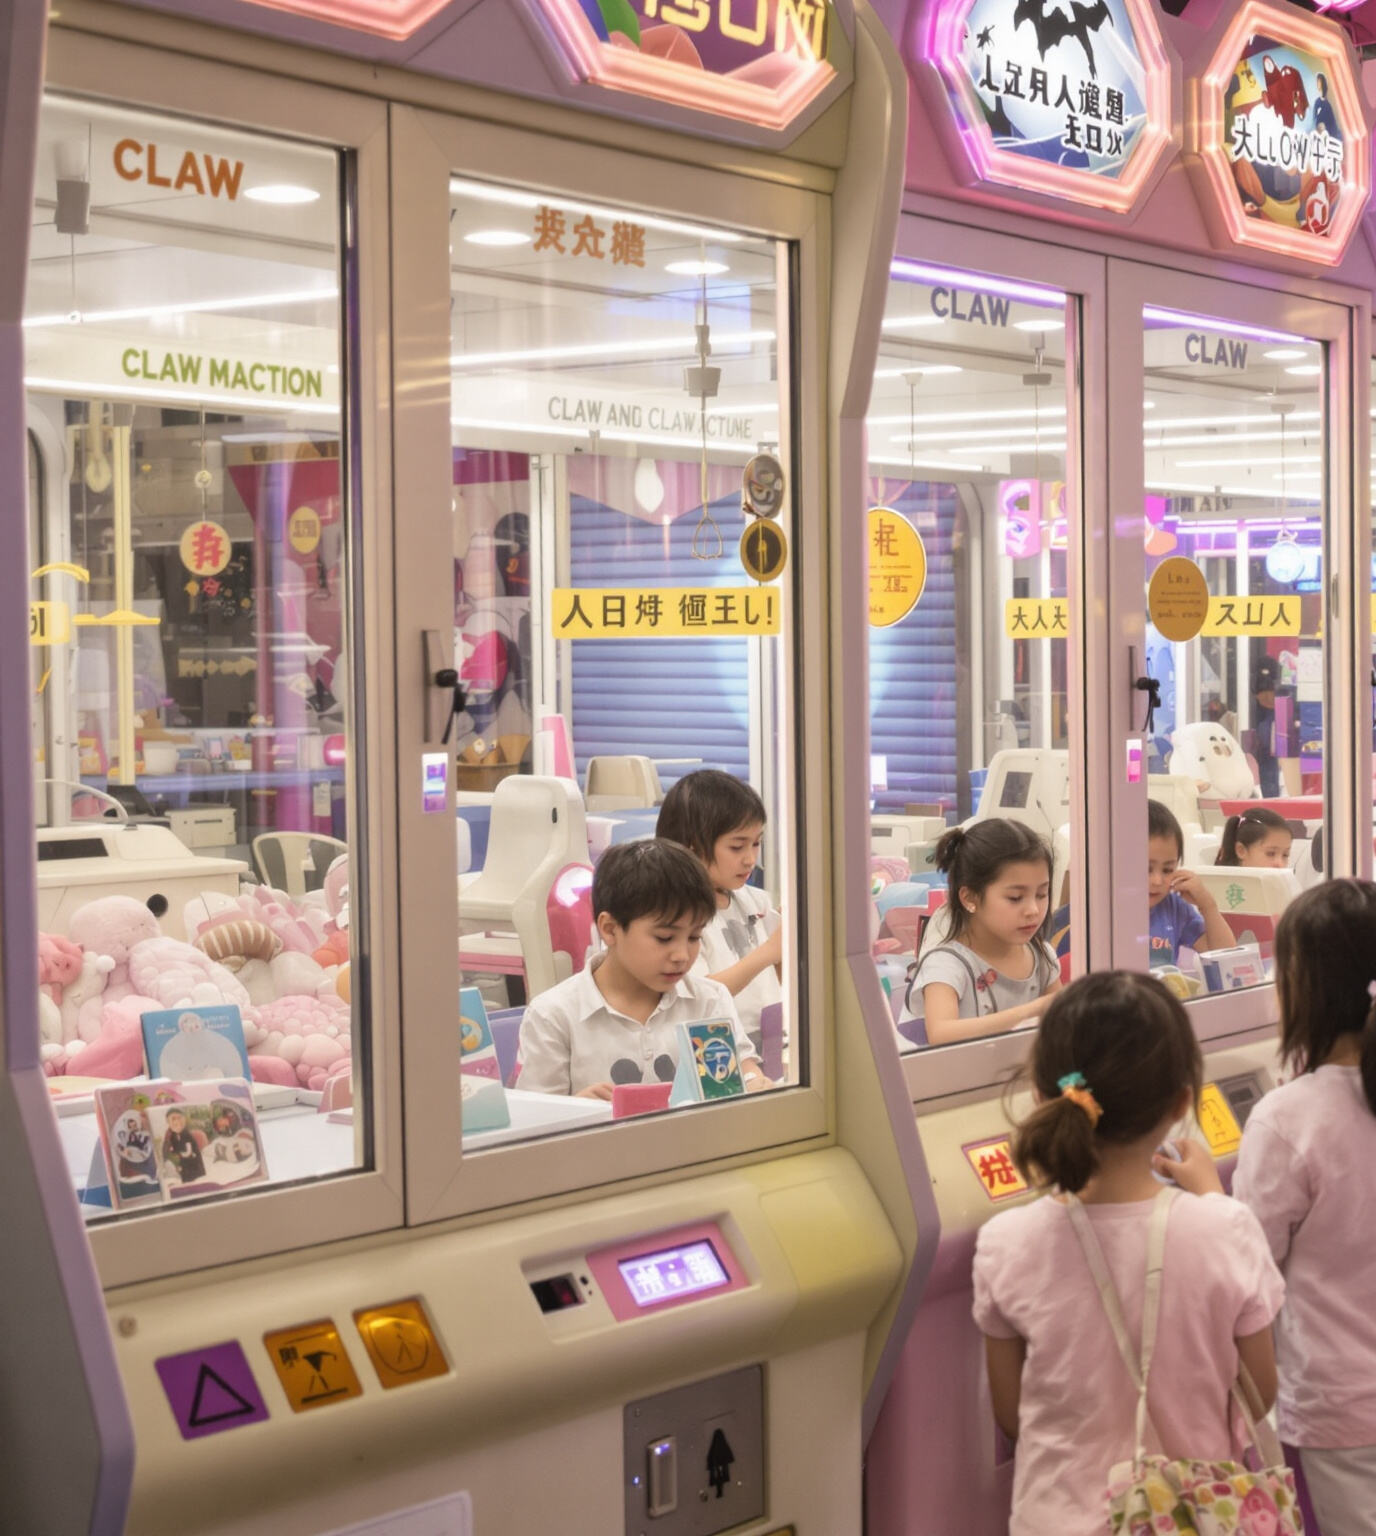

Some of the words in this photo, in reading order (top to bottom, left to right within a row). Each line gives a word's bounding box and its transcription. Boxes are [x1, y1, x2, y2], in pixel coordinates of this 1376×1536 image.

[113, 138, 245, 202] CLAW
[931, 286, 1010, 327] CLAW
[1185, 333, 1248, 369] CLAW
[121, 348, 202, 385] CLAW
[209, 358, 322, 398] MACTION
[548, 396, 602, 424] CLAW
[606, 403, 642, 428] AND
[648, 407, 695, 432] CLAW
